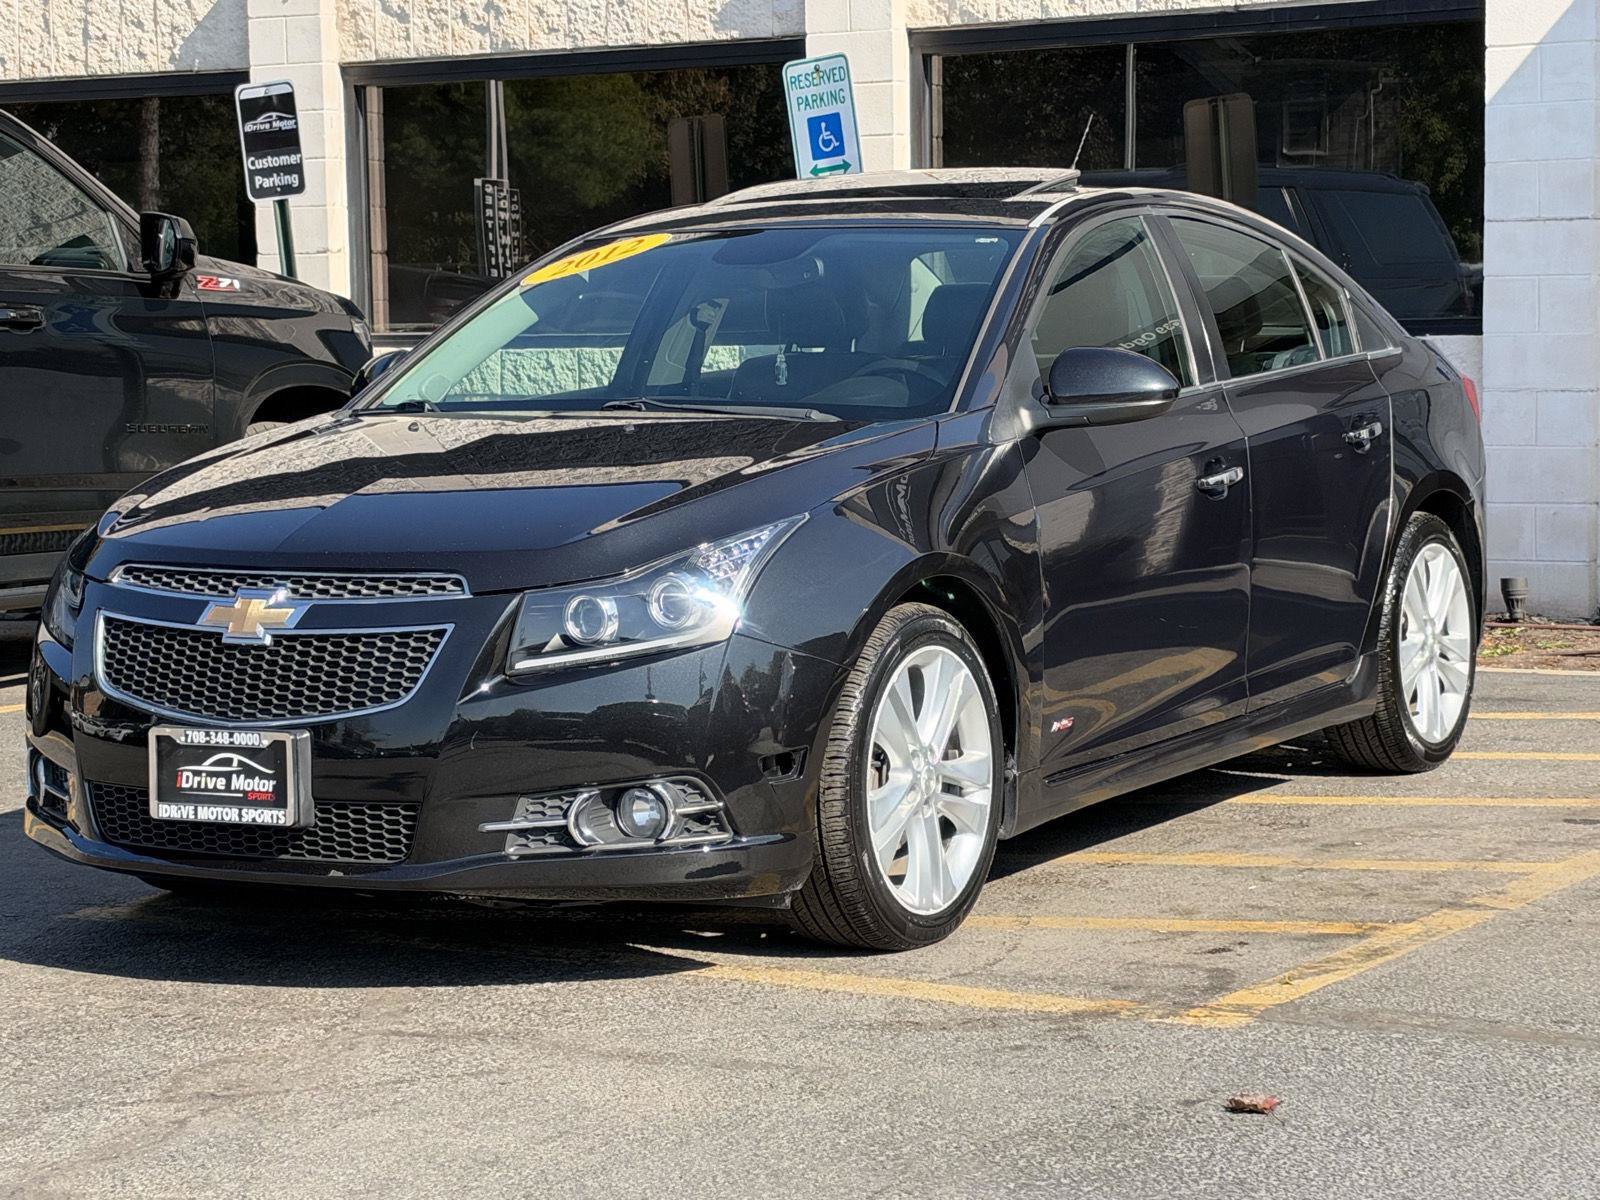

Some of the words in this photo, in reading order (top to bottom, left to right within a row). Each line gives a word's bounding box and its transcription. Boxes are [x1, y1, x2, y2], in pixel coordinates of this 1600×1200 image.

[789, 66, 846, 91] RESERVED
[797, 88, 846, 111] PARKING
[272, 119, 296, 128] Motor
[247, 154, 302, 170] Customer
[255, 173, 299, 189] Parking
[547, 238, 645, 277] 2012
[196, 274, 240, 291] Z71
[126, 423, 209, 434] SUBURBAN
[186, 730, 260, 746] 708-348-0000
[176, 768, 226, 790] iDrive
[230, 773, 277, 792] Motor
[247, 791, 276, 801] SPORTS
[197, 806, 240, 822] MOTOR
[241, 807, 286, 825] SPORTS
